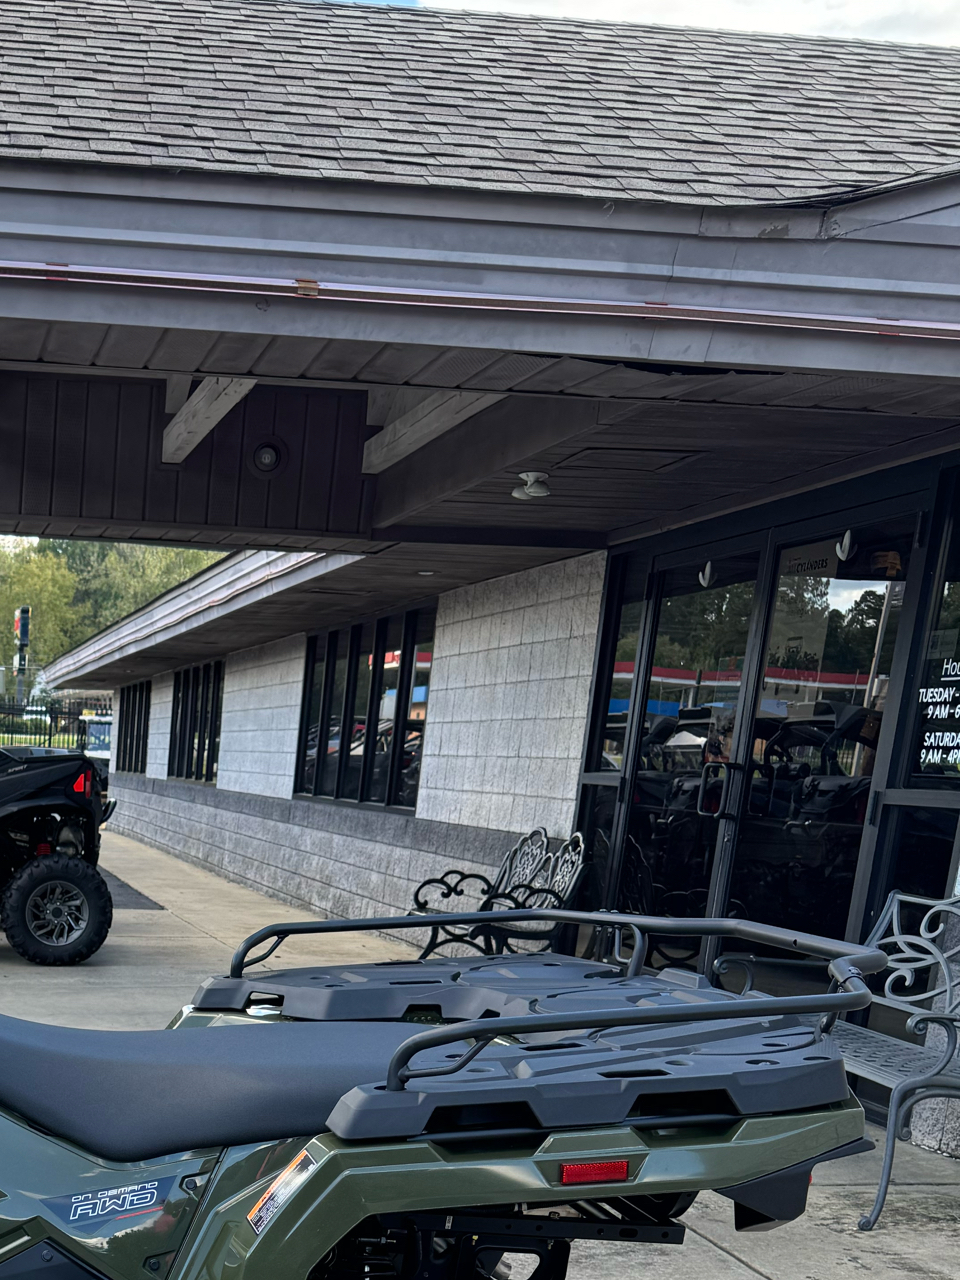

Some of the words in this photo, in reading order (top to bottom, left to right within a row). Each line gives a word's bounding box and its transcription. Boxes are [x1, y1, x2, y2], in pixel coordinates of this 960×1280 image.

[918, 687, 956, 703] TUESDAY
[71, 1193, 91, 1203] ON
[97, 1181, 158, 1198] DEMAND
[69, 1190, 157, 1221] AWD
